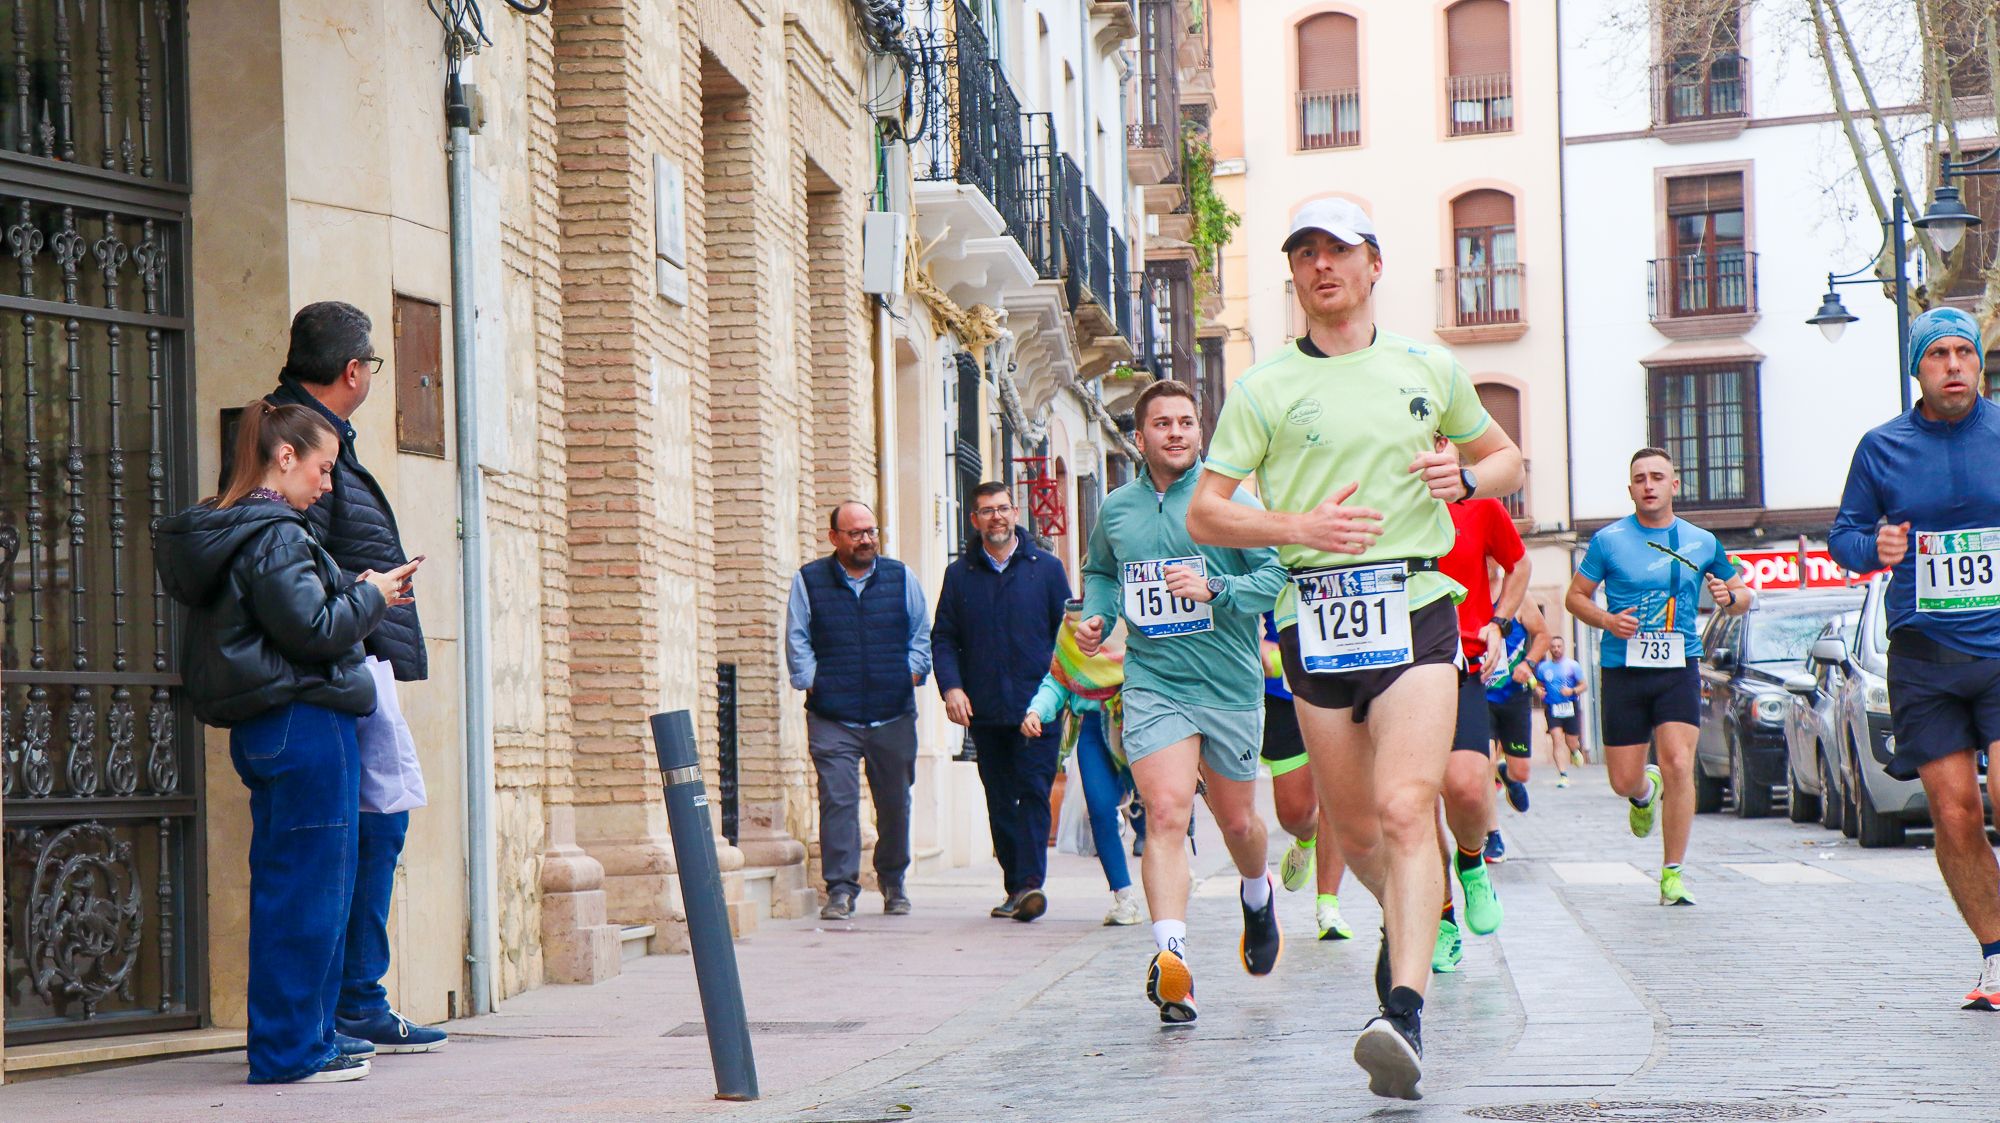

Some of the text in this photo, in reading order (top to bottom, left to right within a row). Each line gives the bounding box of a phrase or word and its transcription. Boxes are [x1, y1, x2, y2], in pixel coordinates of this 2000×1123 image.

[1134, 562, 1158, 582] 21K
[1927, 554, 1993, 587] 1193
[1310, 574, 1343, 599] 21K
[1313, 597, 1387, 641] 1291
[1640, 641, 1670, 660] 733
